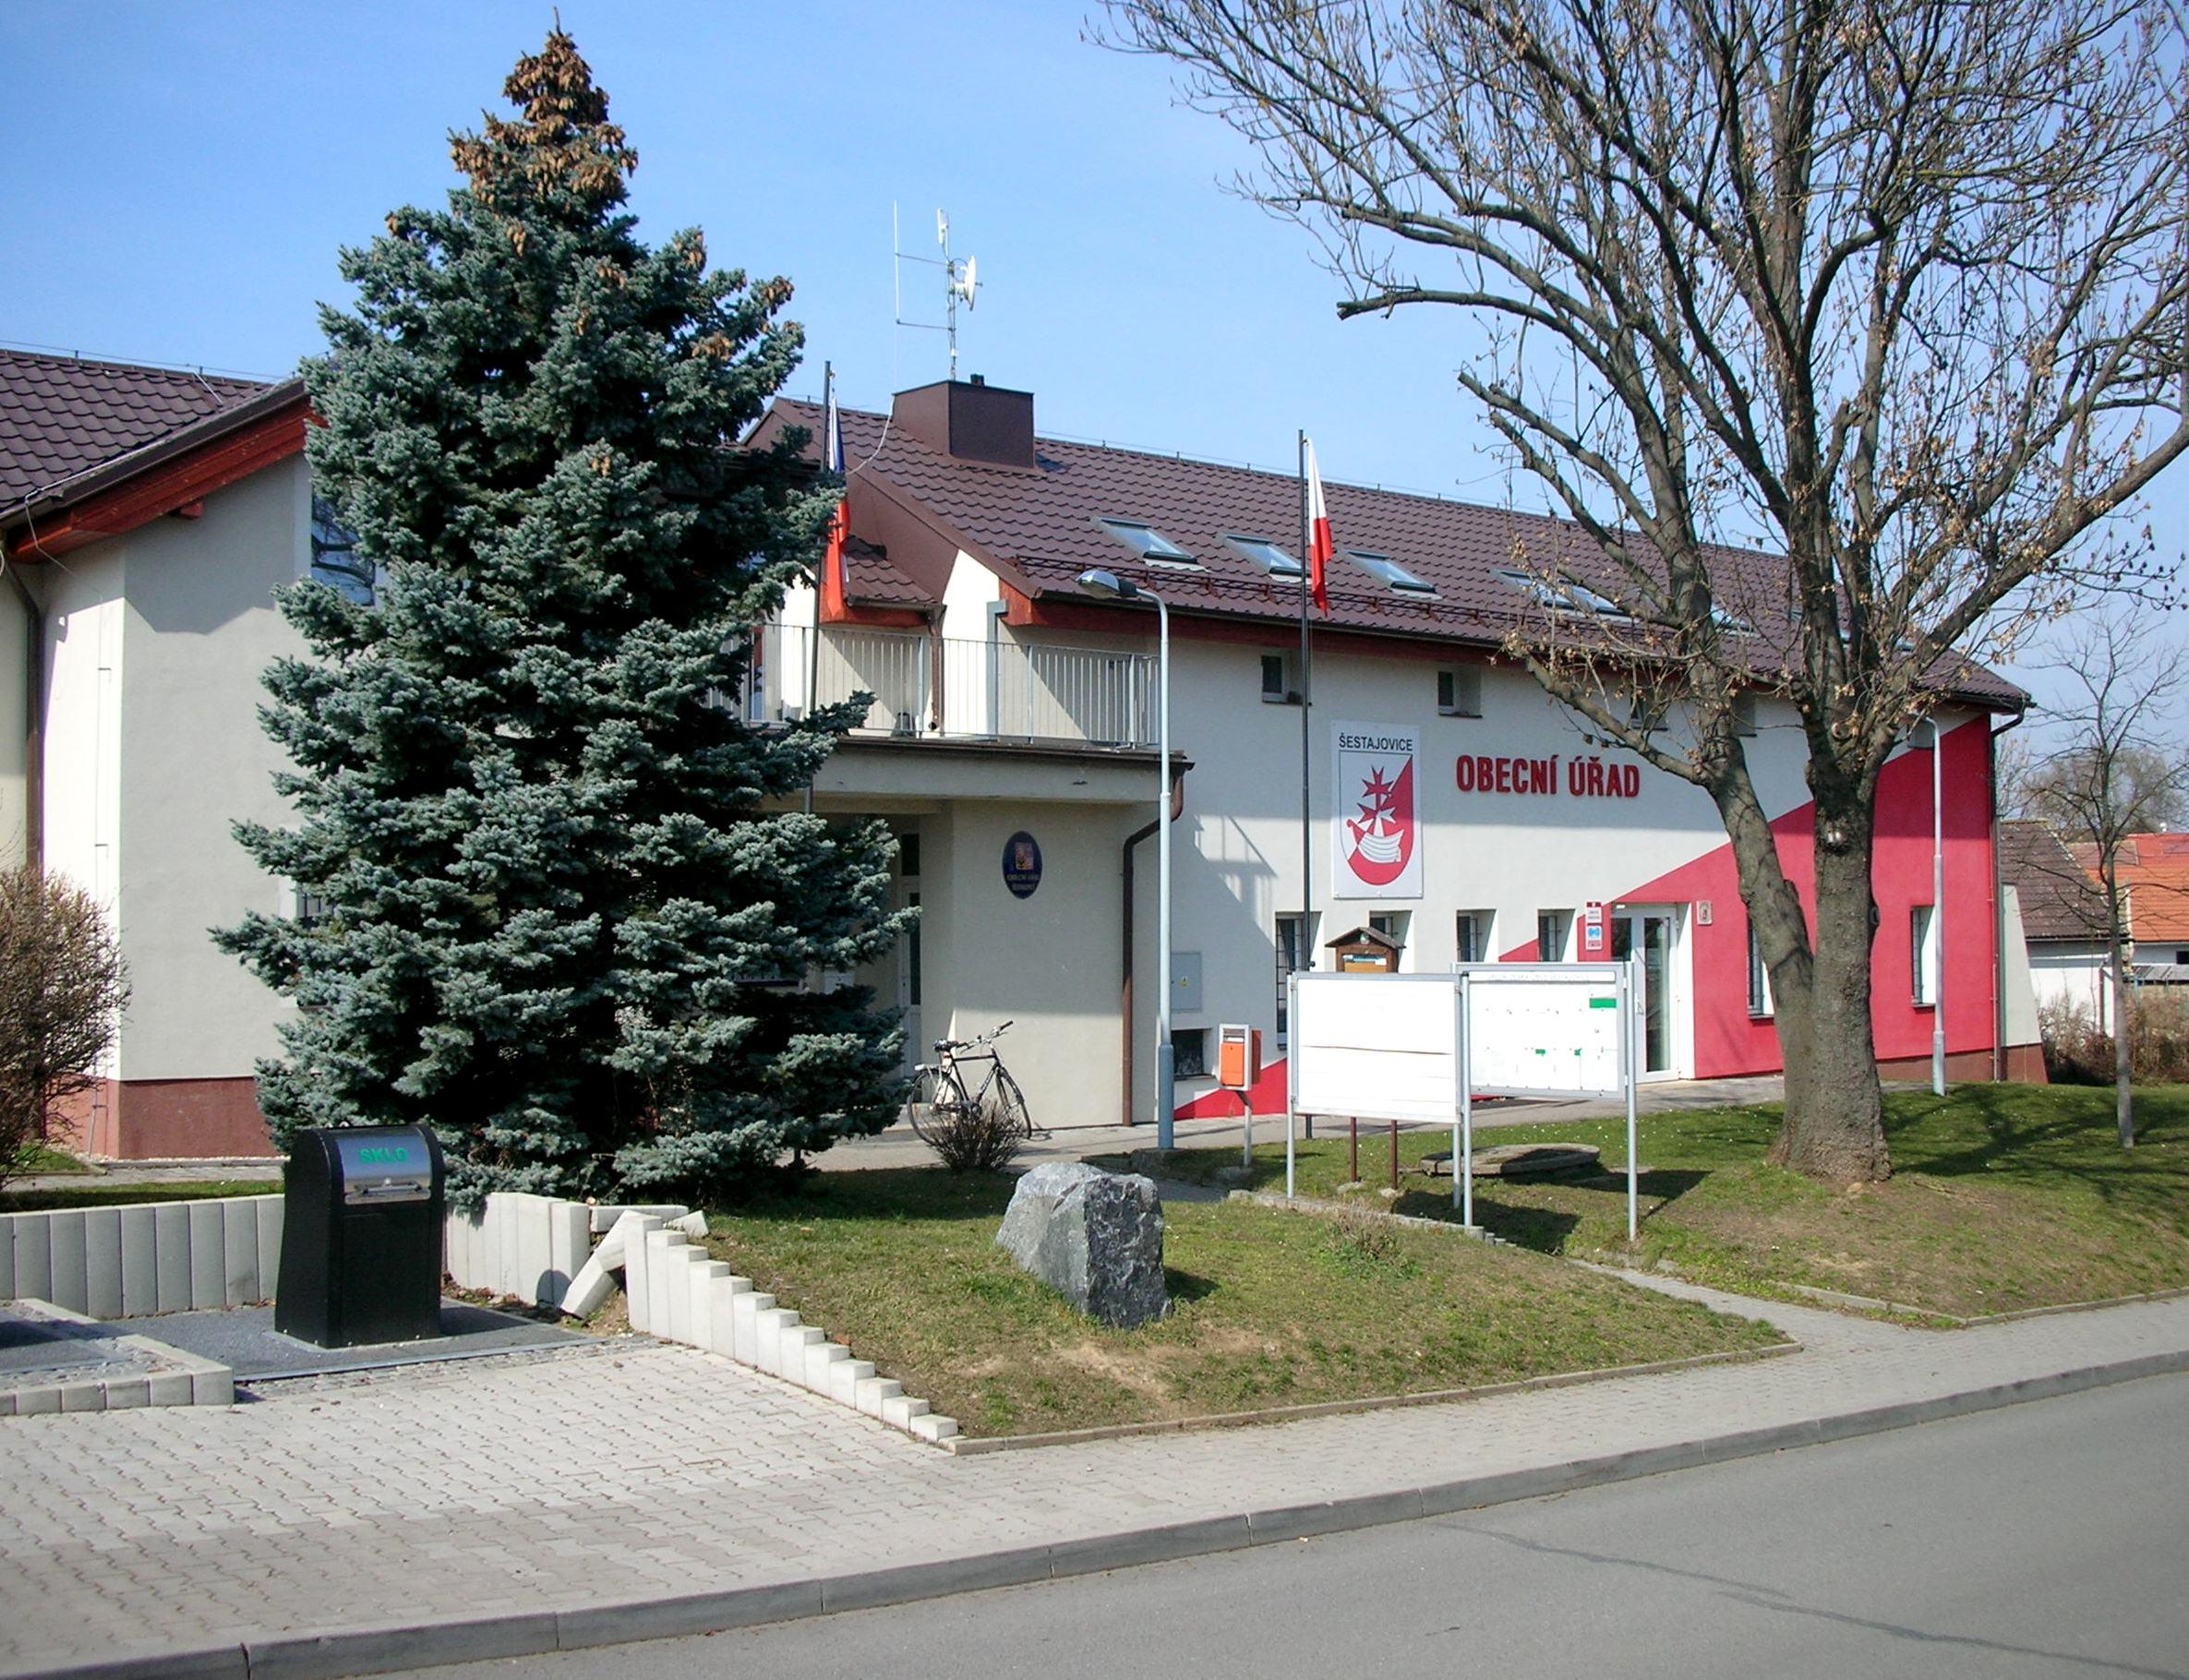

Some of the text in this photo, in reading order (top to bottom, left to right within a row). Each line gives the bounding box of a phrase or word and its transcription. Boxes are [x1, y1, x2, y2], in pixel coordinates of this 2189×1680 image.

[1339, 732, 1413, 751] ŠESTAJOVICE
[1456, 754, 1640, 798] OBECNÍ ÚŘAD
[358, 1147, 408, 1163] SKLO
